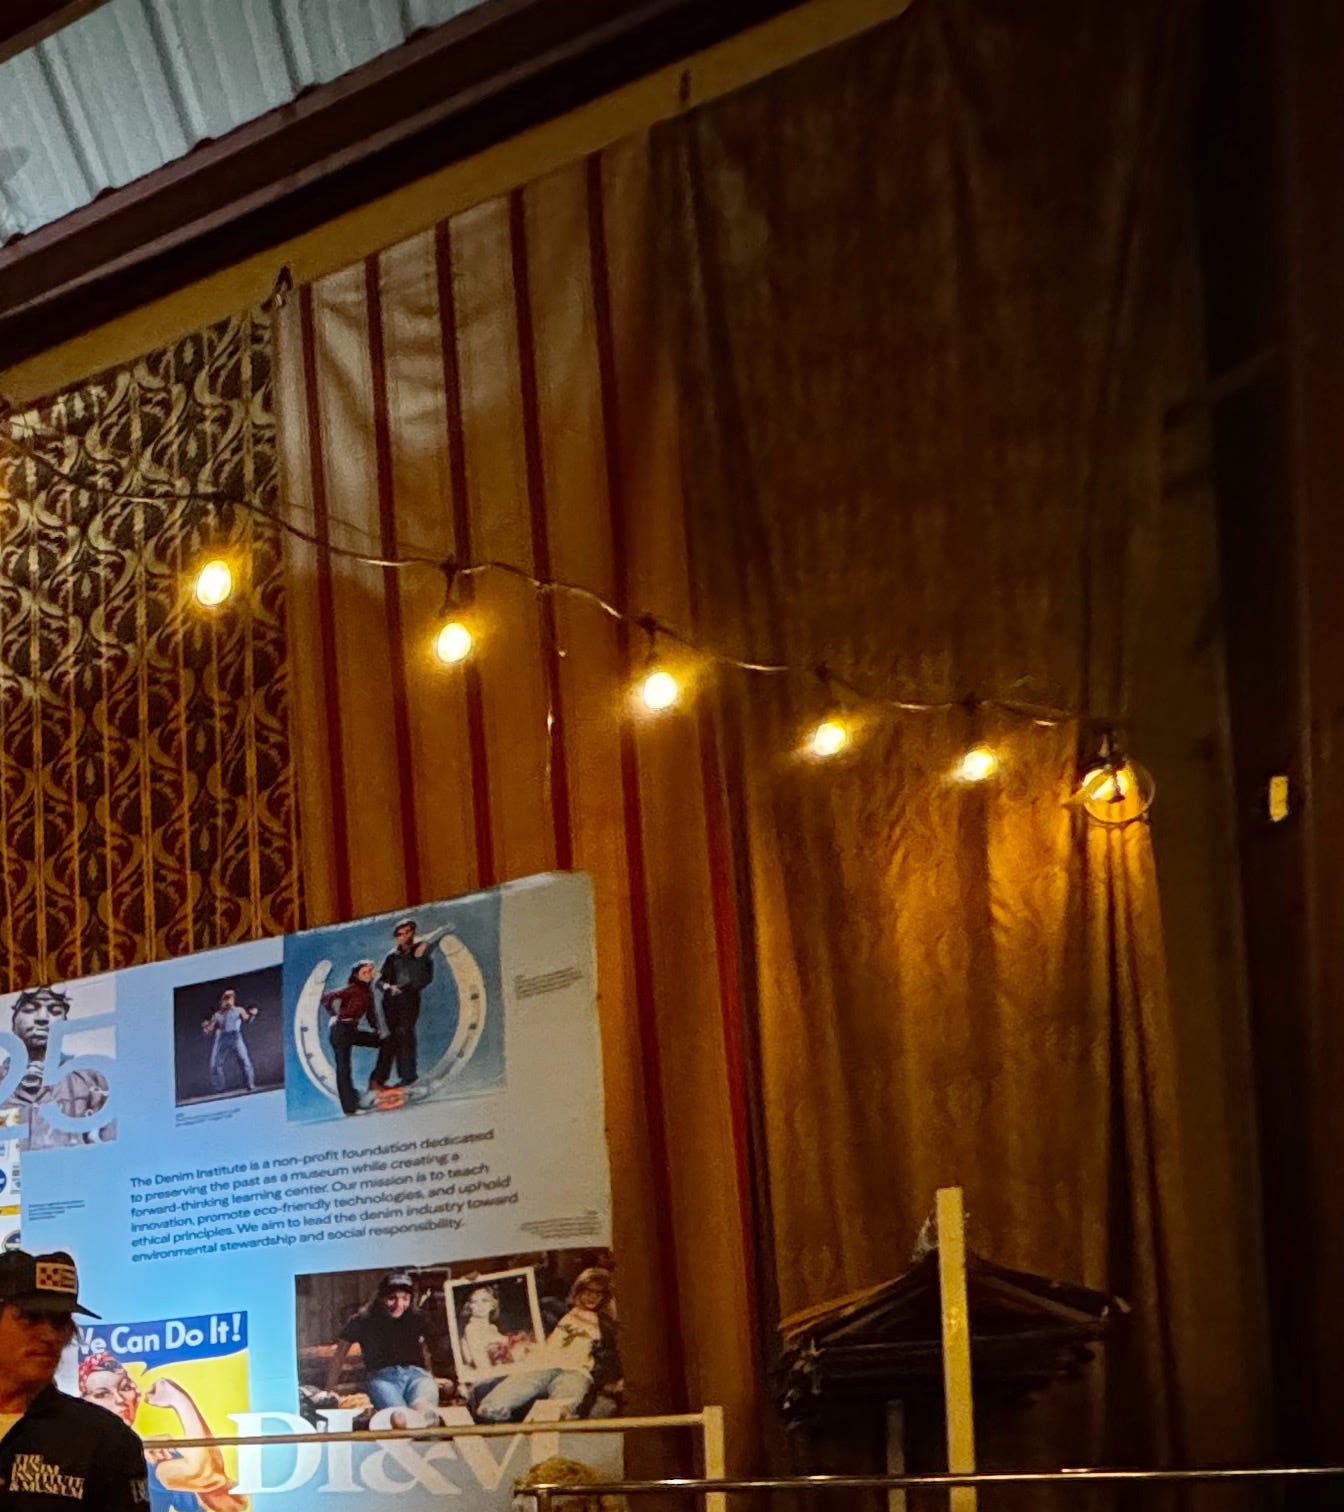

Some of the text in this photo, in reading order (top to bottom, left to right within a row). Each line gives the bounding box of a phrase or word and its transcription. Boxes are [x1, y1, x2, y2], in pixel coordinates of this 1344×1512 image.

[130, 1128, 495, 1188] The Denim Institute is a non-profit foundation dedicated
[130, 1151, 460, 1204] to preserving the past as a museum while creating a
[131, 1162, 490, 1217] forward-thinking learning center. Our mission is to teach
[131, 1175, 511, 1233] innovation, promote eco-friendly technologies, and uphold
[131, 1192, 520, 1247] ethical principles. We aim to lead the denim industry toward
[132, 1218, 465, 1263] environmental stewardship and social responsibility.
[110, 1326, 160, 1355] Can
[165, 1320, 204, 1350] Do
[209, 1312, 242, 1345] It!
[226, 1399, 568, 1497] DI&M
[12, 1471, 85, 1488] INSTITUTE
[22, 1481, 83, 1500] MUSEUM
